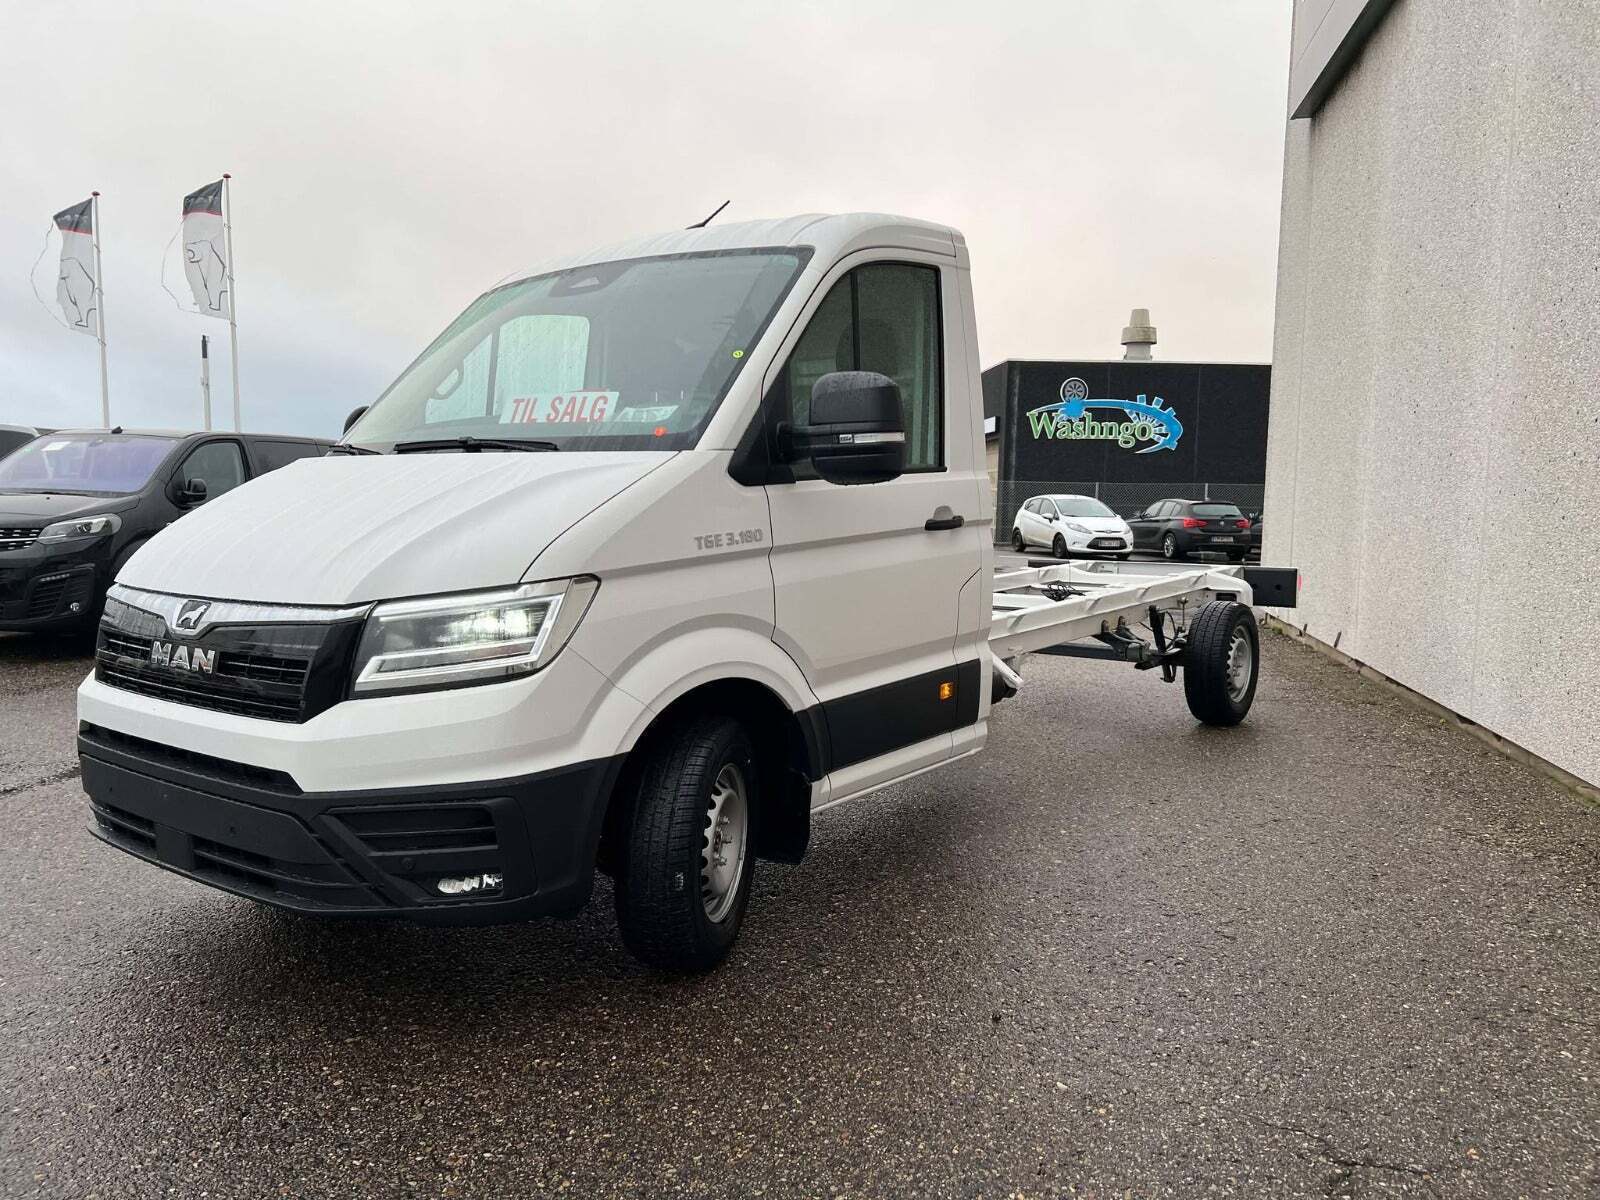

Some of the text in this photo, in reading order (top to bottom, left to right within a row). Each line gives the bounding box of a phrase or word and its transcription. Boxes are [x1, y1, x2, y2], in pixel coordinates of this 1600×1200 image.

[511, 395, 609, 424] TIL SALG
[1026, 411, 1154, 448] Washngo
[694, 529, 763, 551] TGE 3.180
[151, 641, 216, 674] MAN
